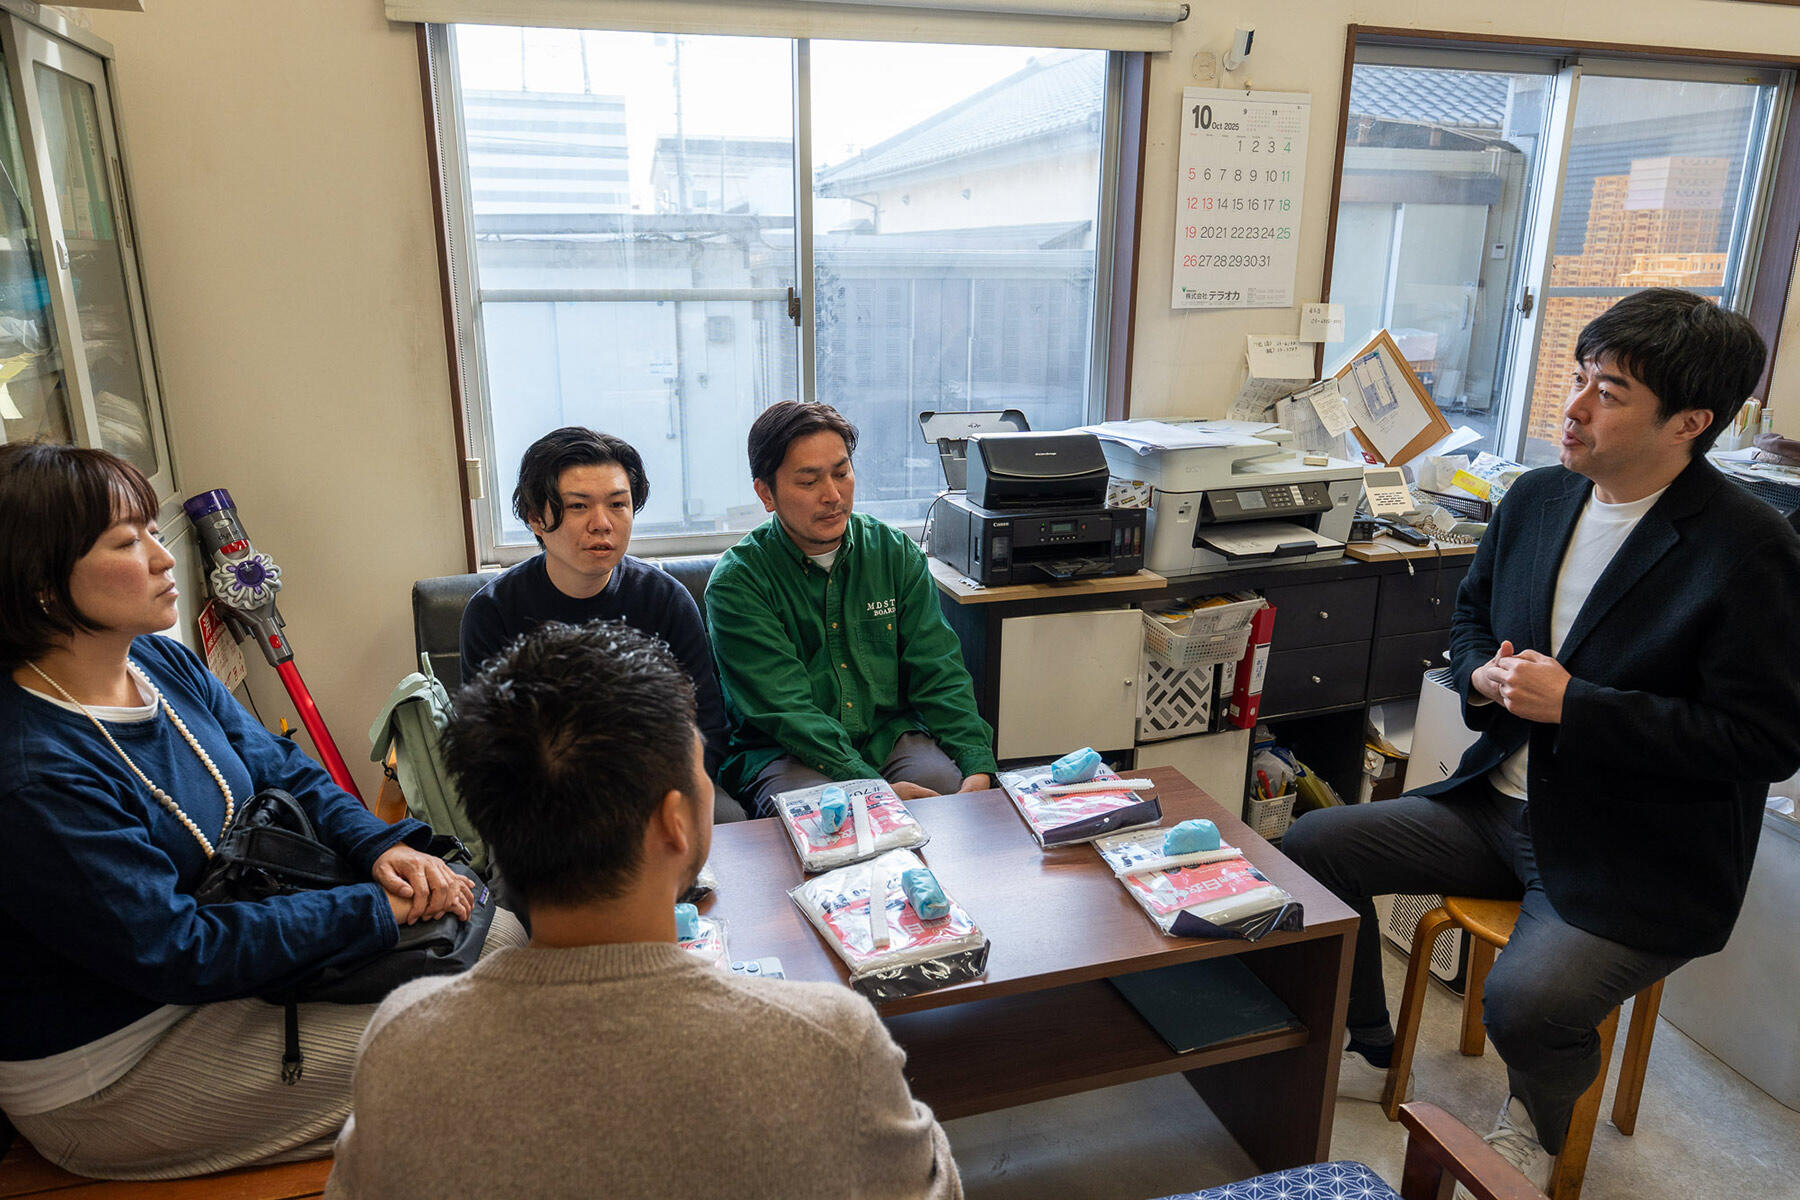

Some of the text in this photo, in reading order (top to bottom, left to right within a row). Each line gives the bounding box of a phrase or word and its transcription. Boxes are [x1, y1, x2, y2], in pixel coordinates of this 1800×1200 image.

[1192, 105, 1240, 131] 10 Oct 2025
[1238, 140, 1291, 153] 1 2 3 4
[1188, 168, 1290, 182] 5 6 7 8 9 10 11
[1187, 197, 1290, 211] 12 13 14 15 16 17 18
[1185, 226, 1291, 239] 19 20 21 22 23 24 25
[1183, 255, 1271, 267] 26 27 28 29 30 31
